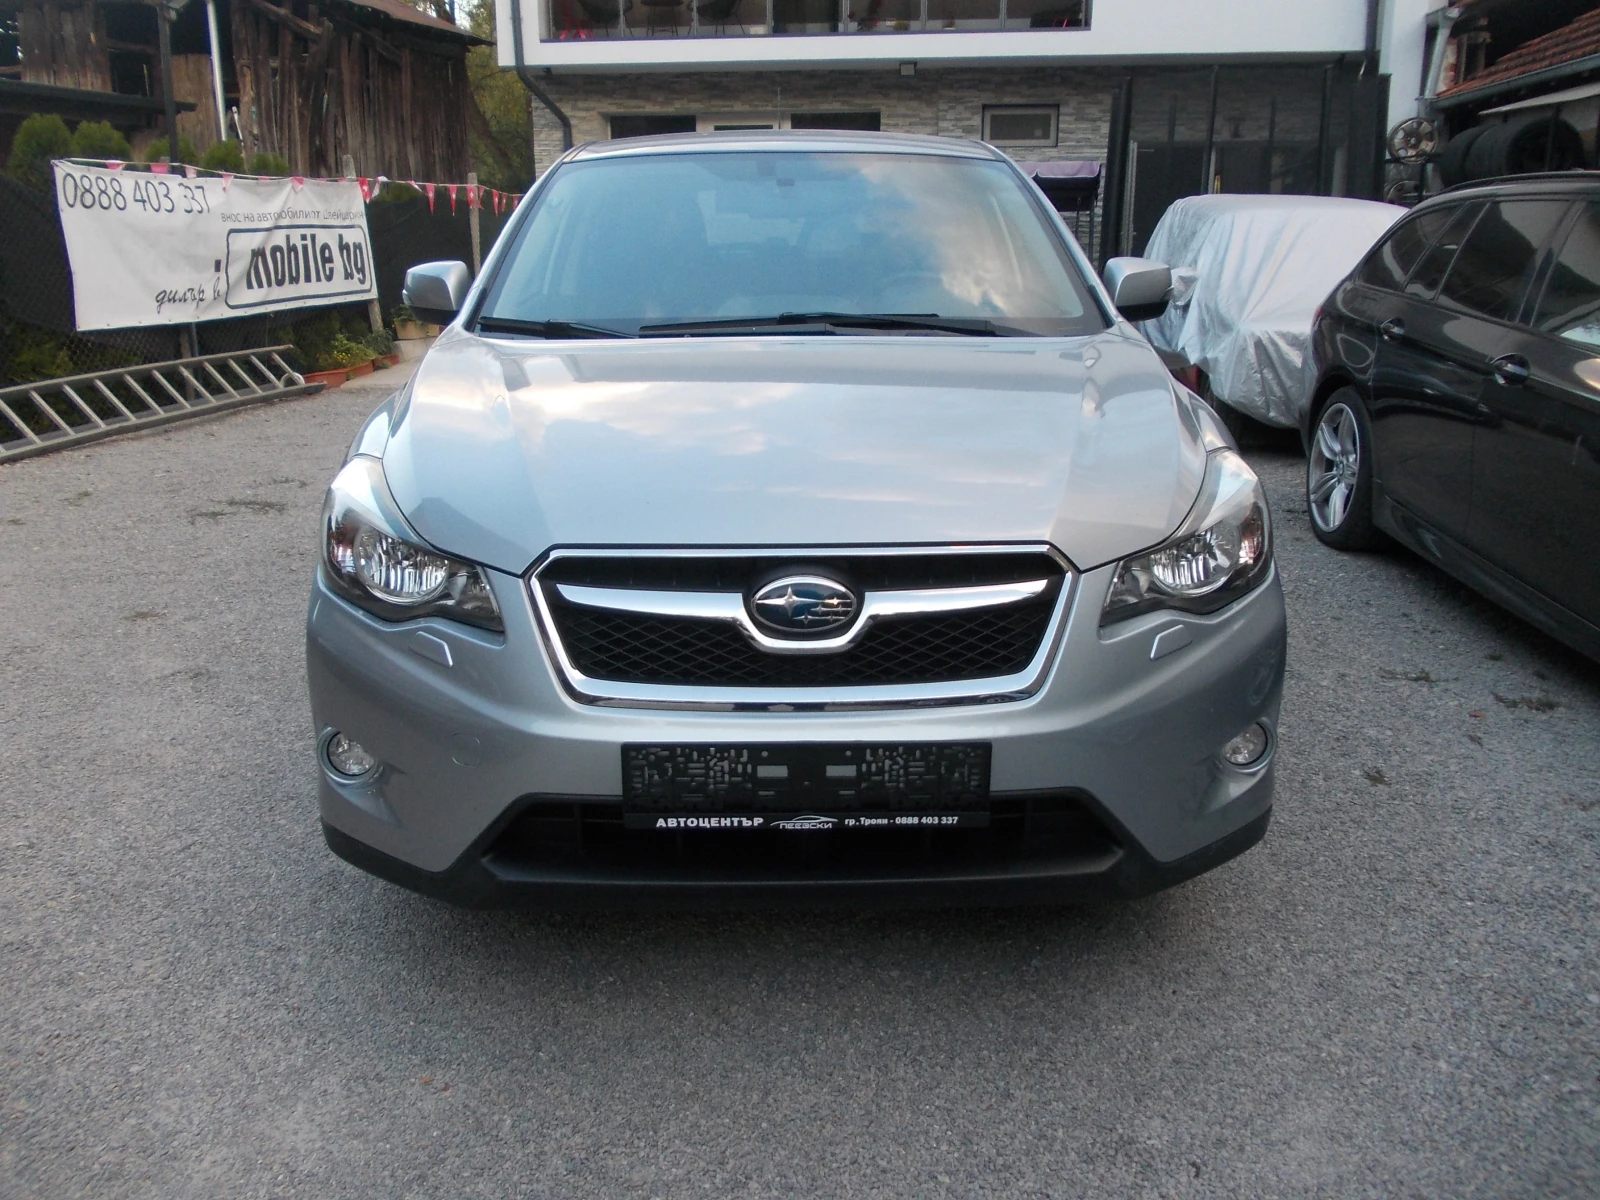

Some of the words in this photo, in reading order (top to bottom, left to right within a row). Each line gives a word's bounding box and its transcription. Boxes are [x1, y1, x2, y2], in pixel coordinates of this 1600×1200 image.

[62, 172, 127, 211] 0888
[133, 179, 175, 213] 403
[243, 213, 255, 222] на
[246, 233, 335, 290] mobile
[338, 233, 366, 285] bg
[656, 817, 764, 828] АВТОЦЕНТЪР
[895, 816, 918, 824] 0888
[921, 816, 939, 824] 403
[941, 816, 959, 824] 337
